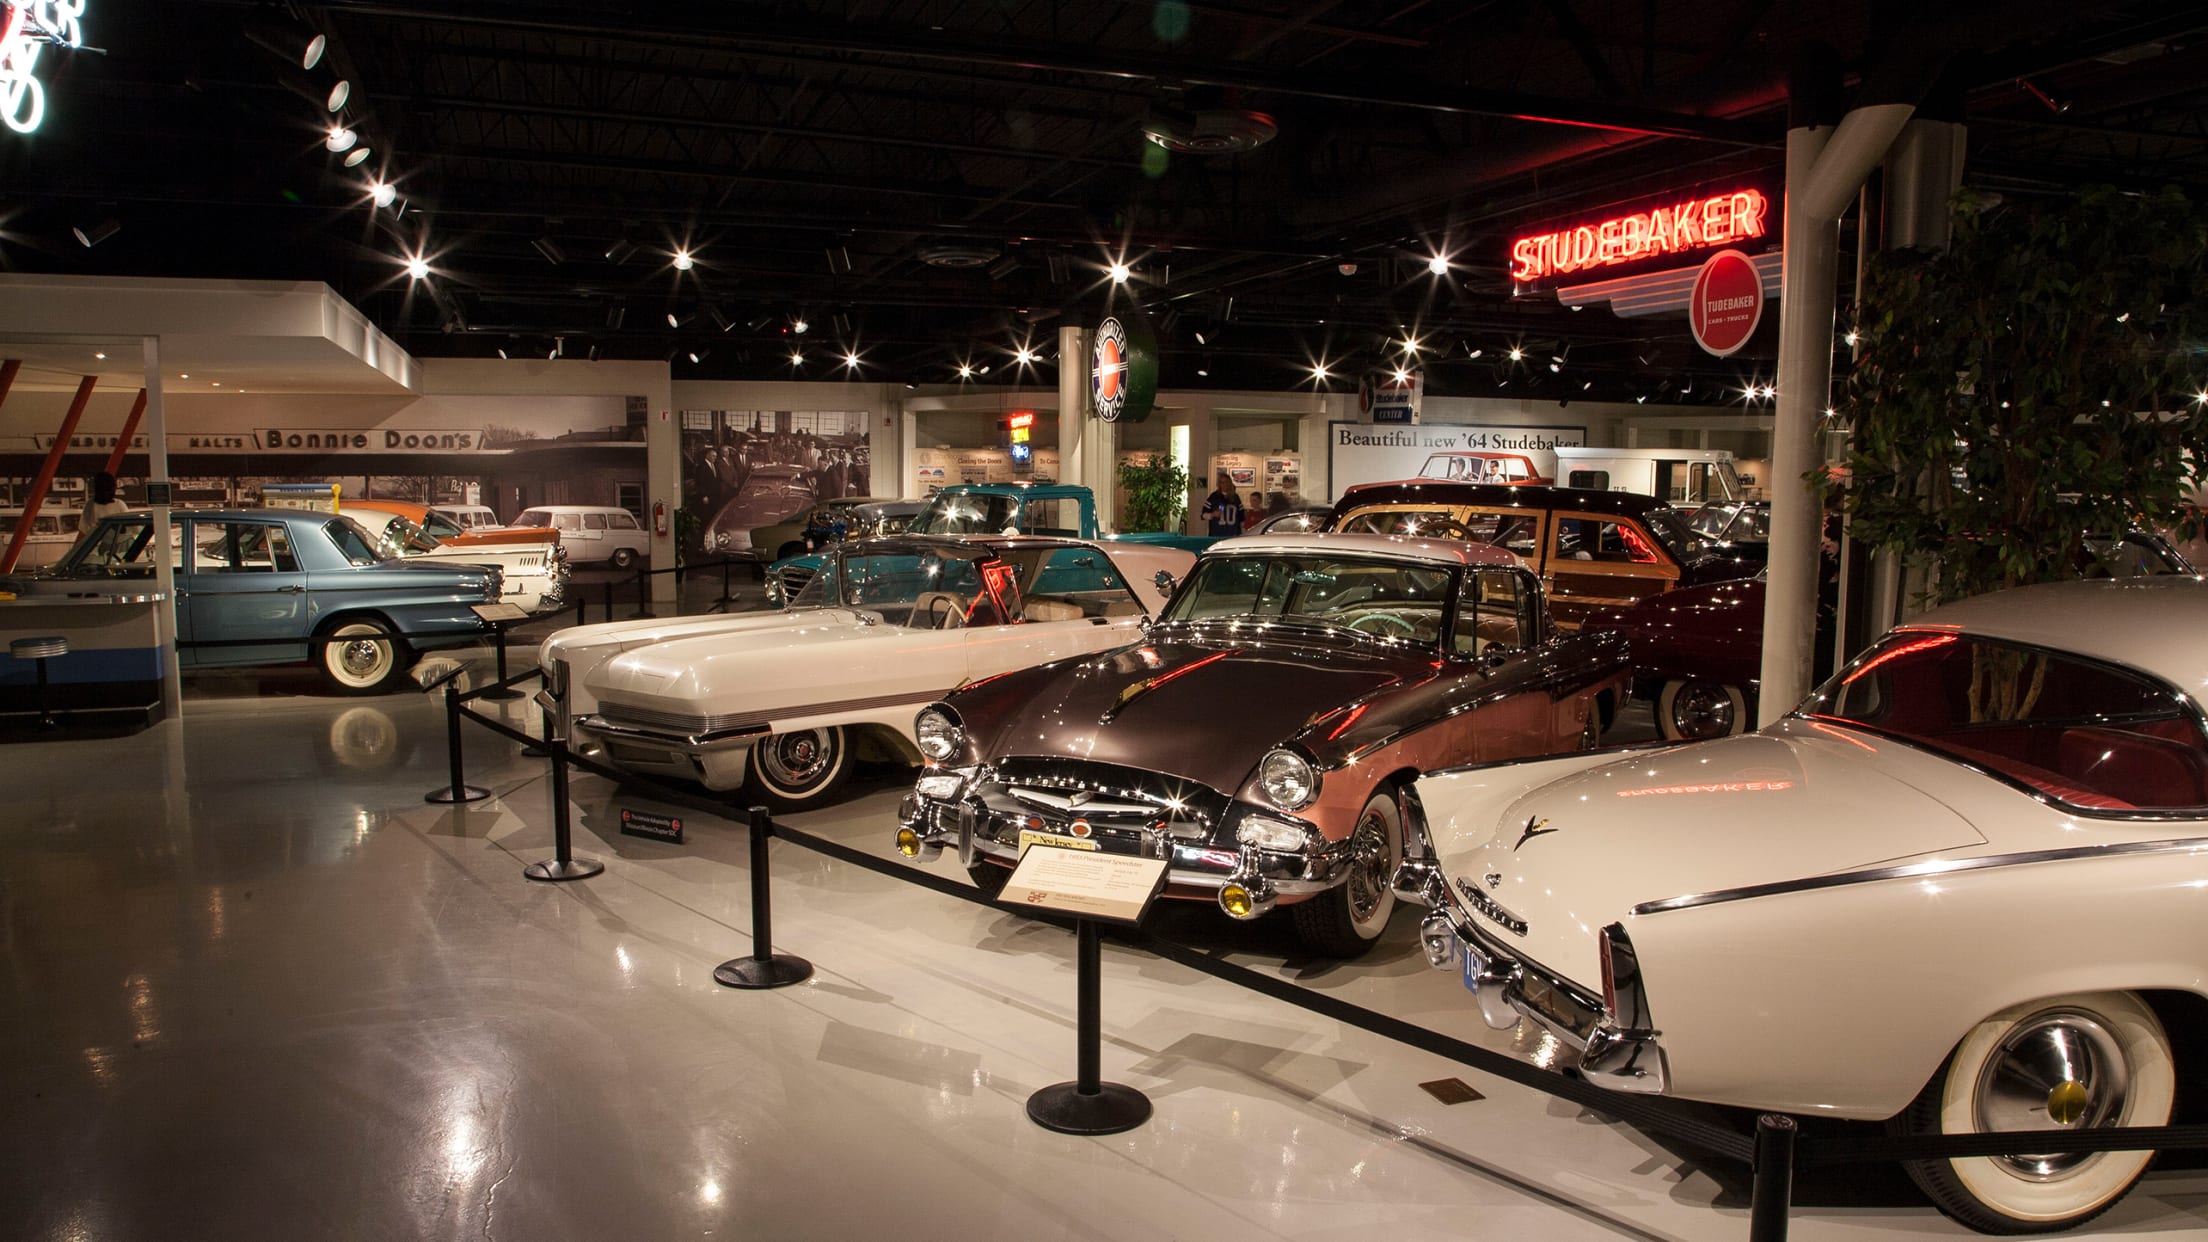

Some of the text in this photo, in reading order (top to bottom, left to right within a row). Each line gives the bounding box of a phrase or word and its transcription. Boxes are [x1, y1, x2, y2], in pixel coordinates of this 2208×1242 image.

[1513, 189, 1766, 279] STUDEBAKER
[1708, 314, 1749, 325] CARS TRUCKS
[1096, 383, 1125, 417] SERVICE
[1379, 410, 1403, 420] CENTER
[190, 438, 243, 448] MALTS
[267, 430, 472, 449] Bonnie Doon's
[1339, 430, 1417, 447] Beautiful
[1424, 437, 1456, 448] new
[1492, 433, 1580, 450] Studebaker
[1218, 504, 1237, 526] 10
[1040, 835, 1073, 848] New Jersey
